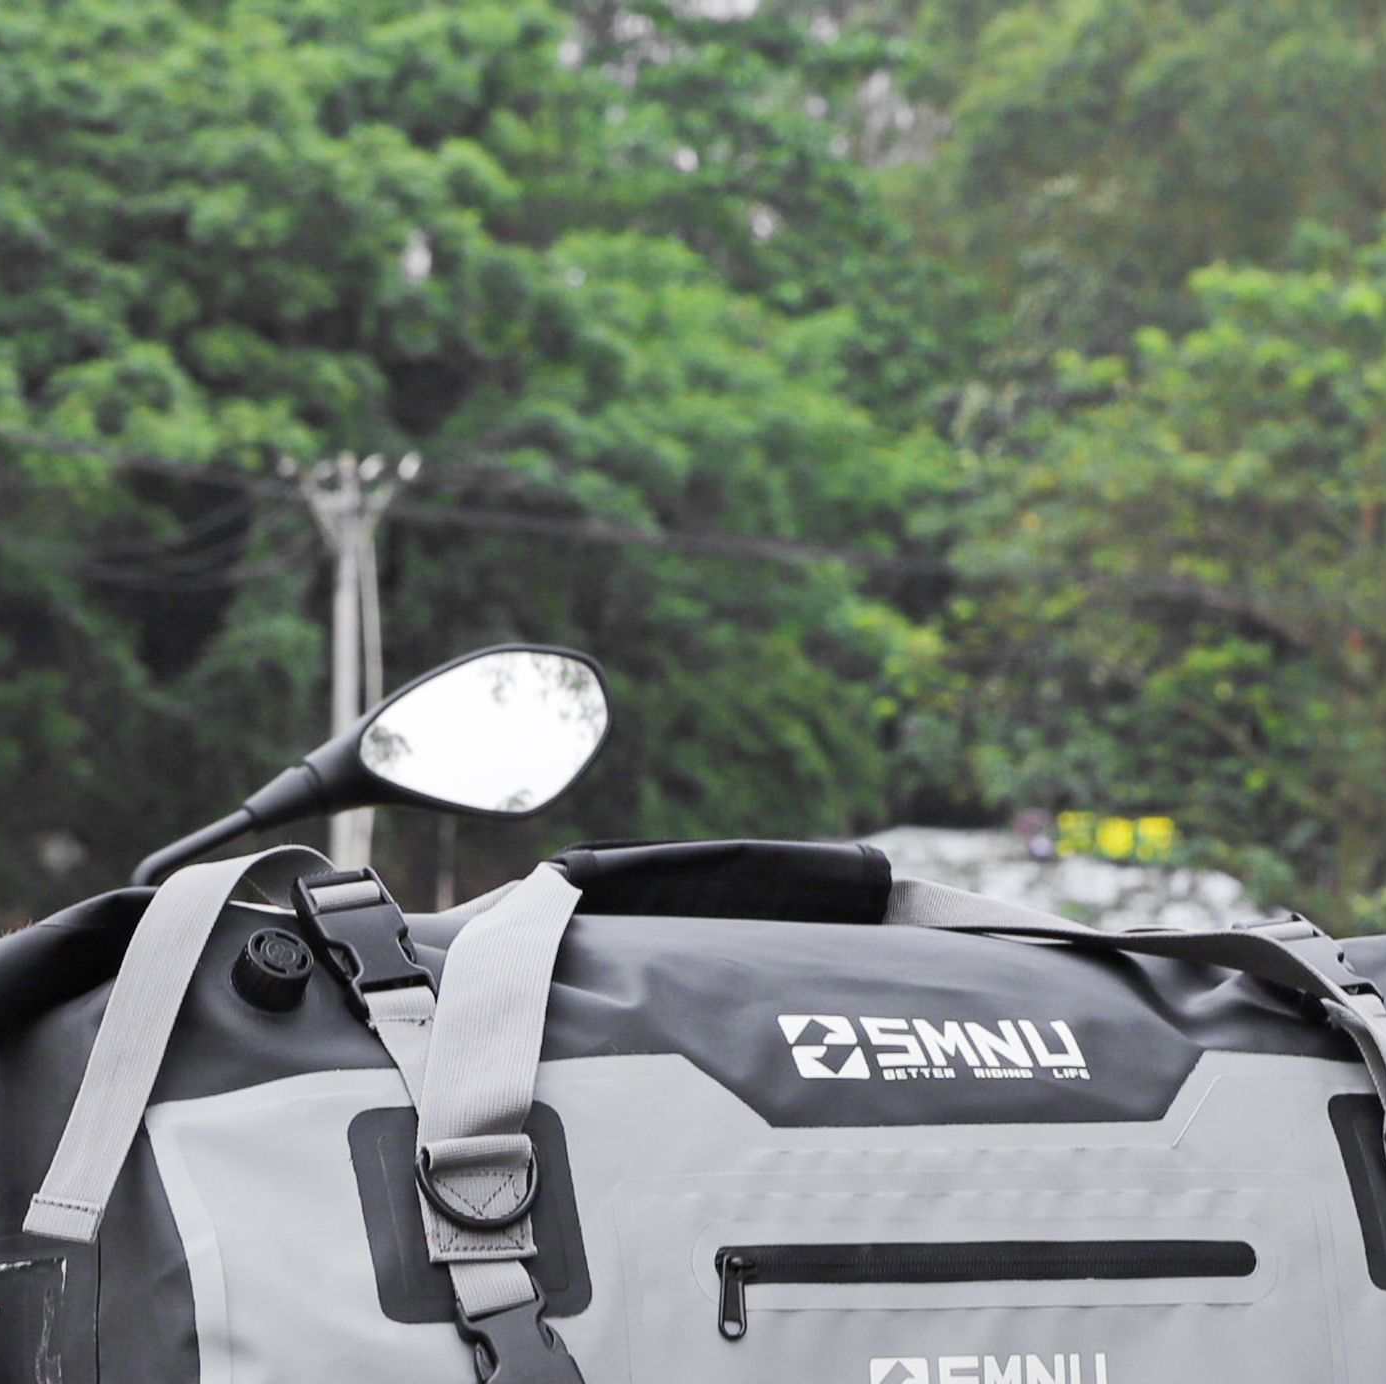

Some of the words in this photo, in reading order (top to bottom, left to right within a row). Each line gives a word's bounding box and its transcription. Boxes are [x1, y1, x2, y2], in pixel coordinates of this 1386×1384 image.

[859, 1016, 1086, 1068] SMNU
[883, 1068, 956, 1081] BETTER
[974, 1067, 1033, 1079] RIDING
[1051, 1068, 1091, 1081] LIFE
